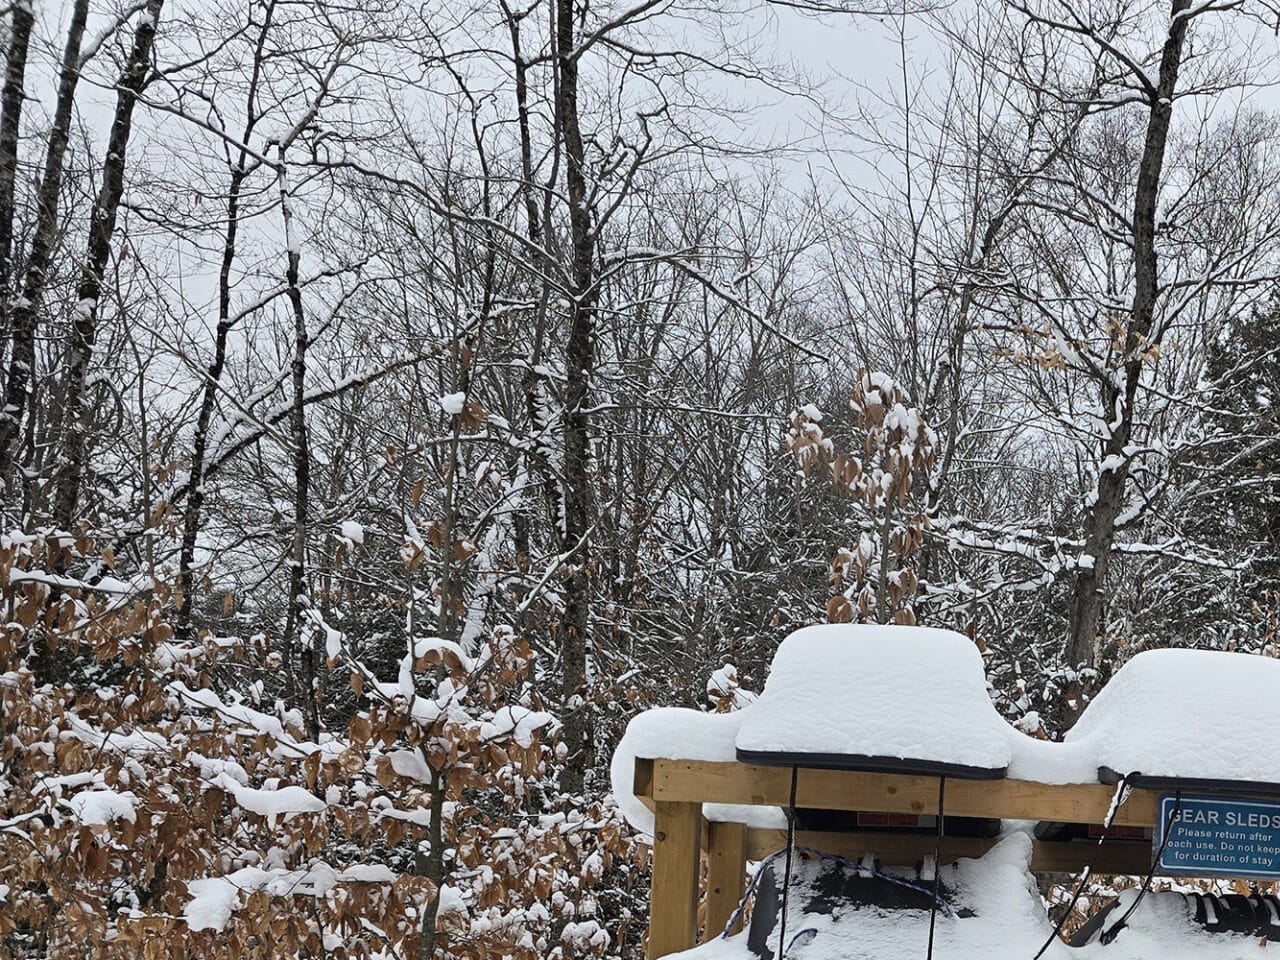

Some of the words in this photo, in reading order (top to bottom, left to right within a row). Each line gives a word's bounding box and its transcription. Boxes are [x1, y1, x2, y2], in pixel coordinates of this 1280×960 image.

[1168, 809, 1219, 824] GEAR
[1177, 827, 1211, 838] Please
[1215, 831, 1246, 840] return
[1249, 832, 1272, 841] after
[1168, 840, 1192, 848] each
[1196, 841, 1217, 850] use.
[1220, 841, 1234, 851] Do
[1238, 844, 1254, 852] not
[1257, 844, 1280, 855] keep
[1174, 851, 1190, 860] for
[1192, 852, 1236, 862] duration
[1239, 855, 1250, 863] of
[1251, 856, 1273, 867] stay
